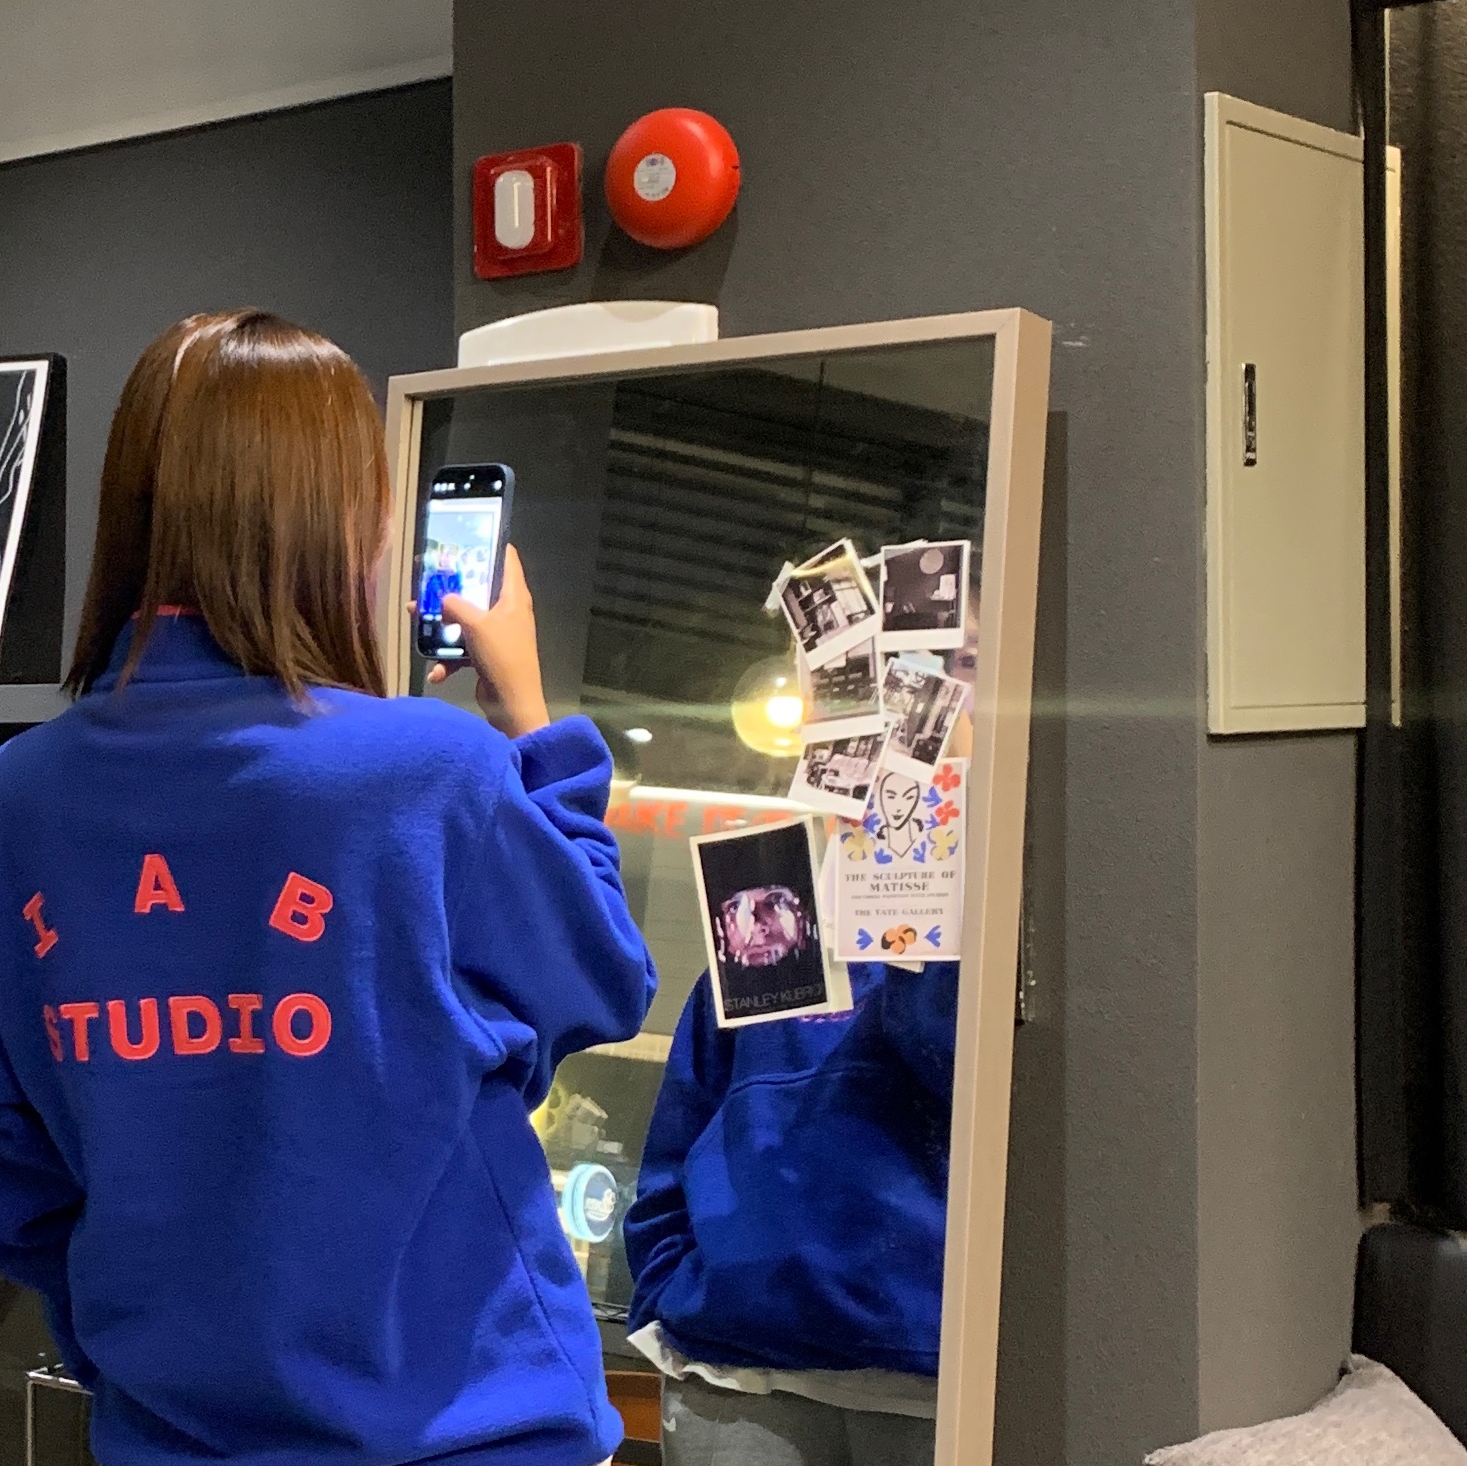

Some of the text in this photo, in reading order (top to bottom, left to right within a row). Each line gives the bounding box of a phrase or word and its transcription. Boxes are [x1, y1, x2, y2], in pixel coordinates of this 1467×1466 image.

[844, 869, 957, 882] THE SCULPTURE OF
[133, 853, 186, 914] A
[268, 871, 335, 942] B
[869, 881, 931, 893] MATISSE
[723, 991, 779, 1012] STANLEY
[43, 992, 333, 1063] STUDIO
